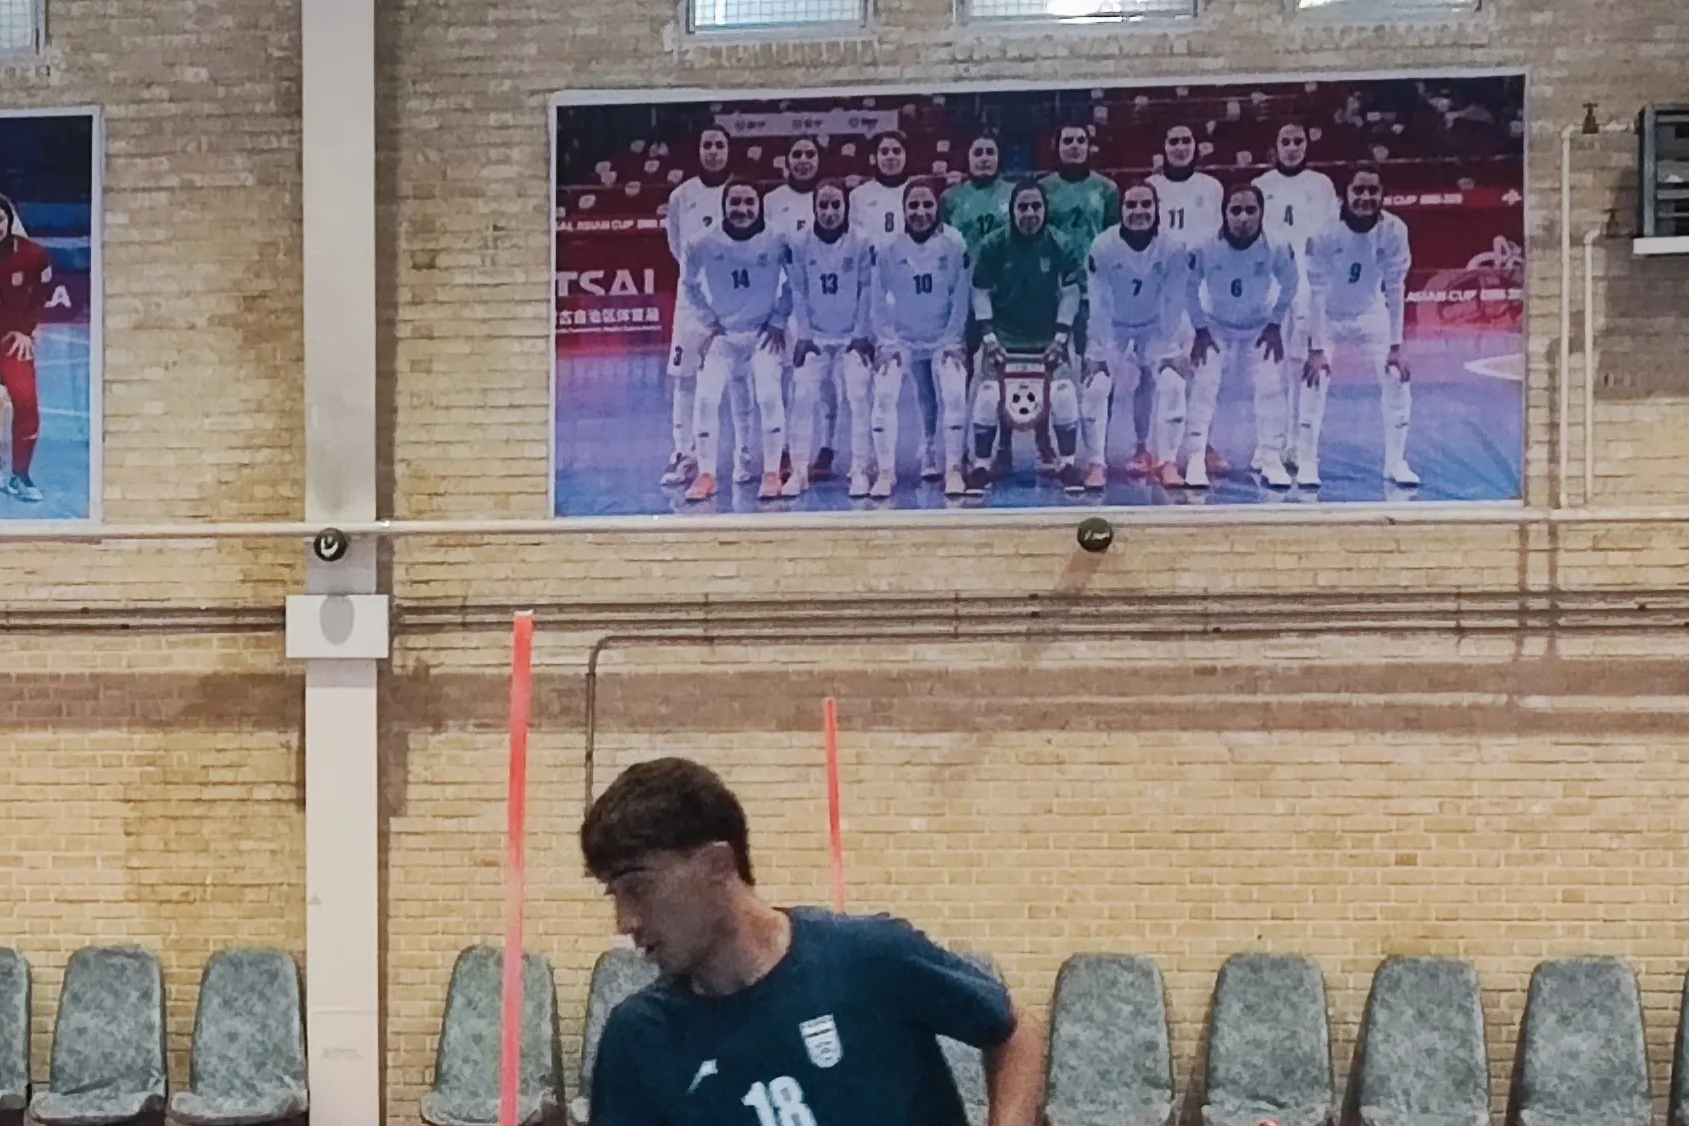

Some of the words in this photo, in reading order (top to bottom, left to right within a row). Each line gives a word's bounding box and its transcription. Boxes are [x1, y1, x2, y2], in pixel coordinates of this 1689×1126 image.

[884, 212, 895, 233] 8
[1168, 207, 1185, 230] 11
[731, 268, 751, 290] 14
[819, 272, 839, 295] 13
[912, 272, 933, 295] 10
[1347, 261, 1363, 285] 9
[1131, 278, 1143, 297] 7
[1230, 278, 1243, 298] 6
